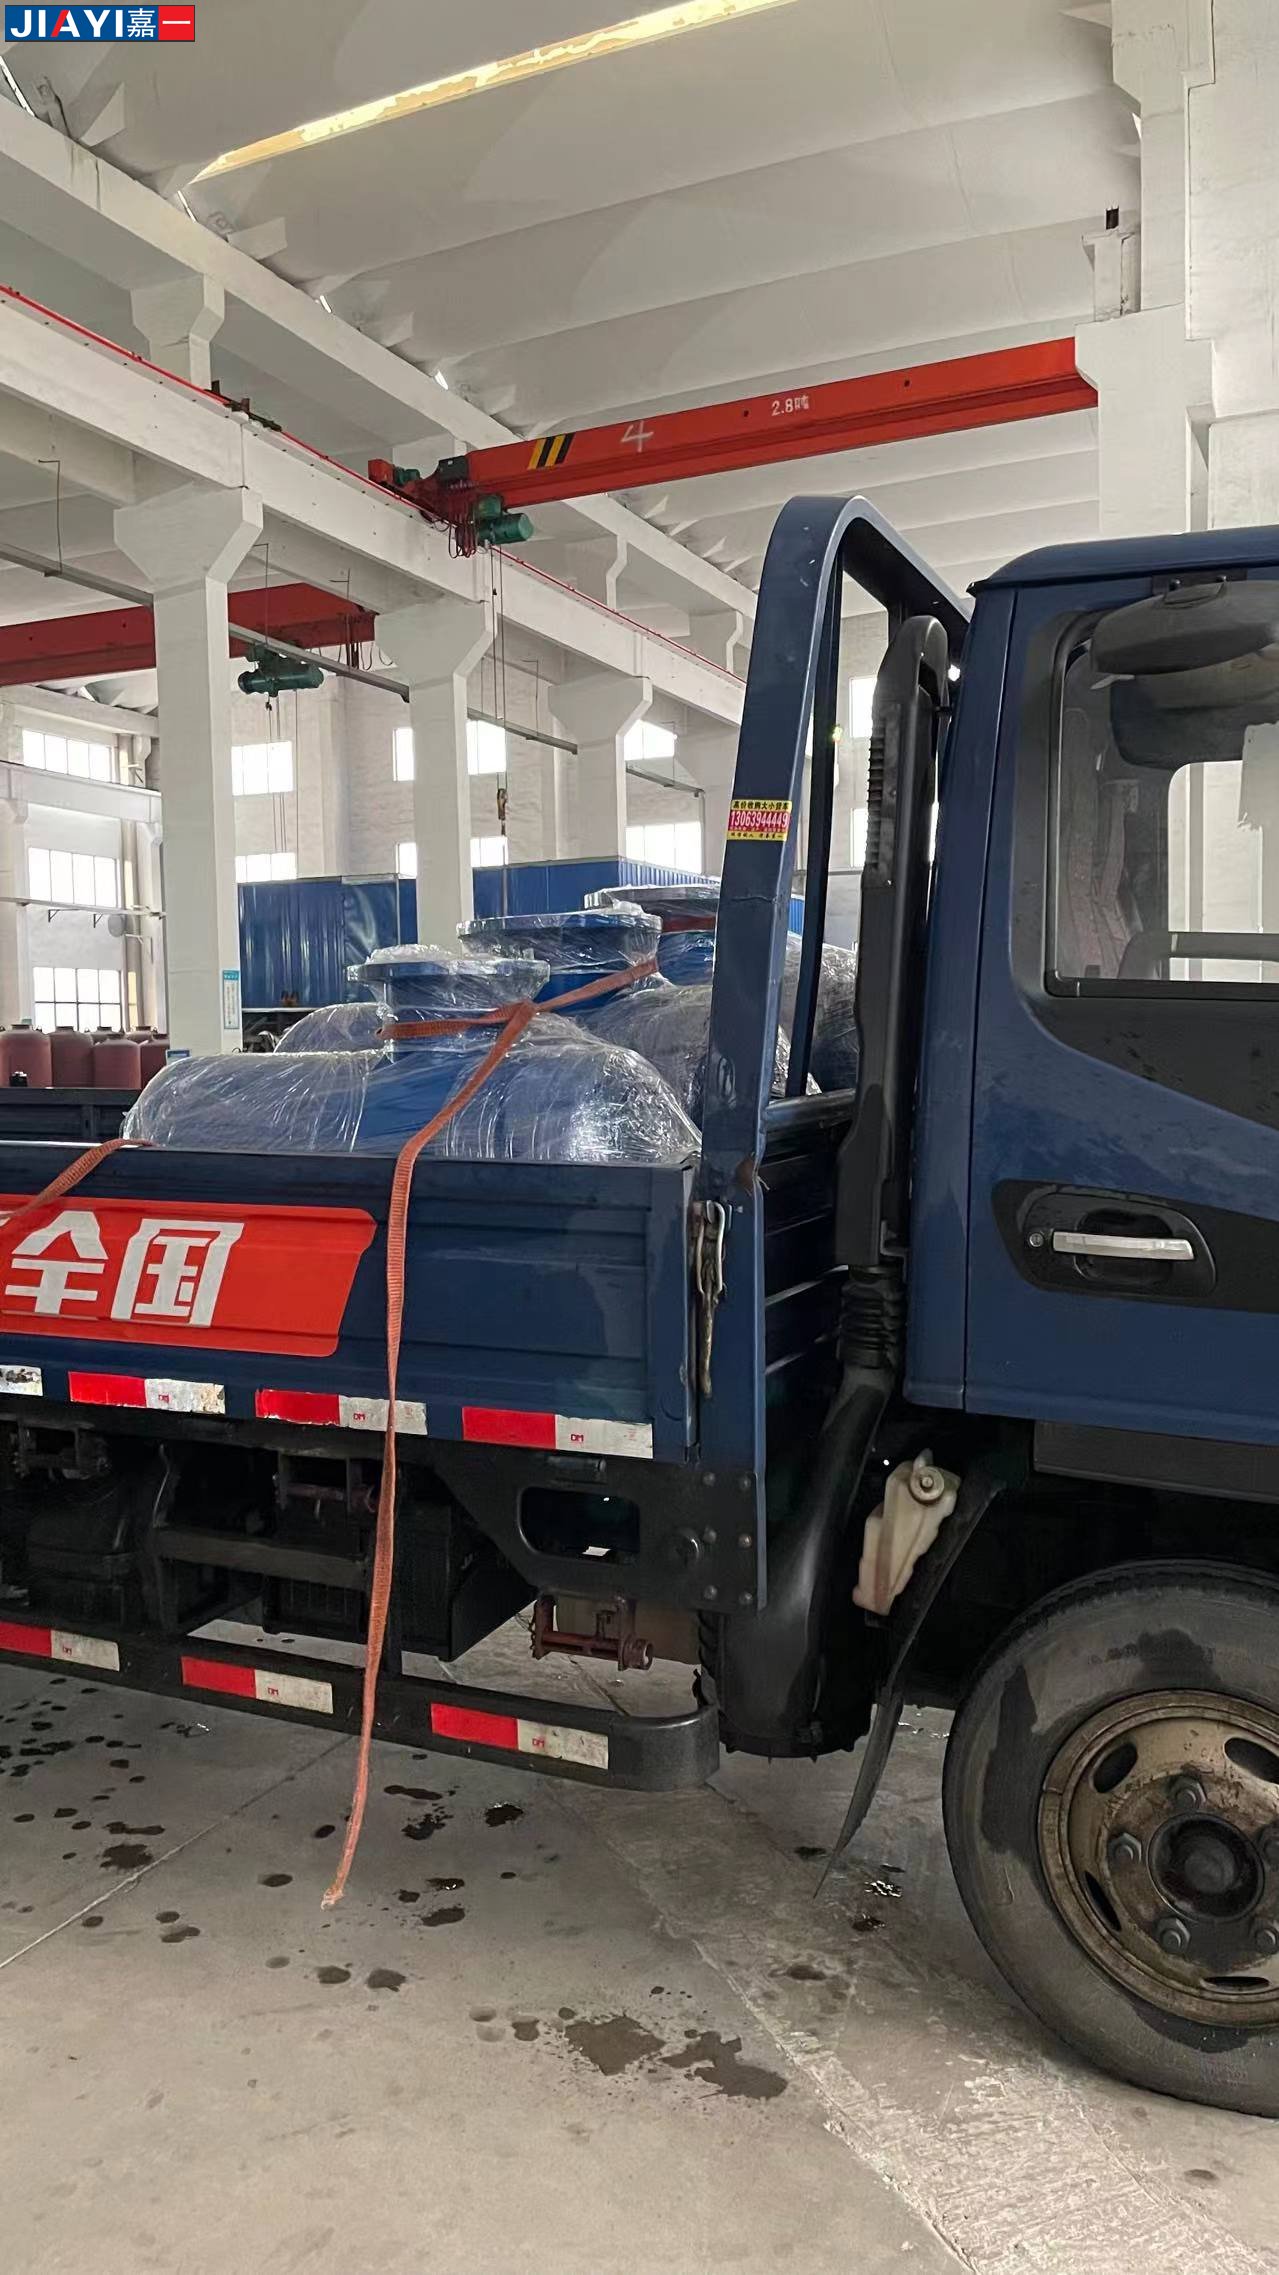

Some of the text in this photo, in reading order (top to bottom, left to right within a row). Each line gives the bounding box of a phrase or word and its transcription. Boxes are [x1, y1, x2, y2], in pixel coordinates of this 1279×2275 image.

[620, 420, 654, 453] 4
[731, 810, 789, 828] 13063944449
[0, 1209, 245, 1328] 全国
